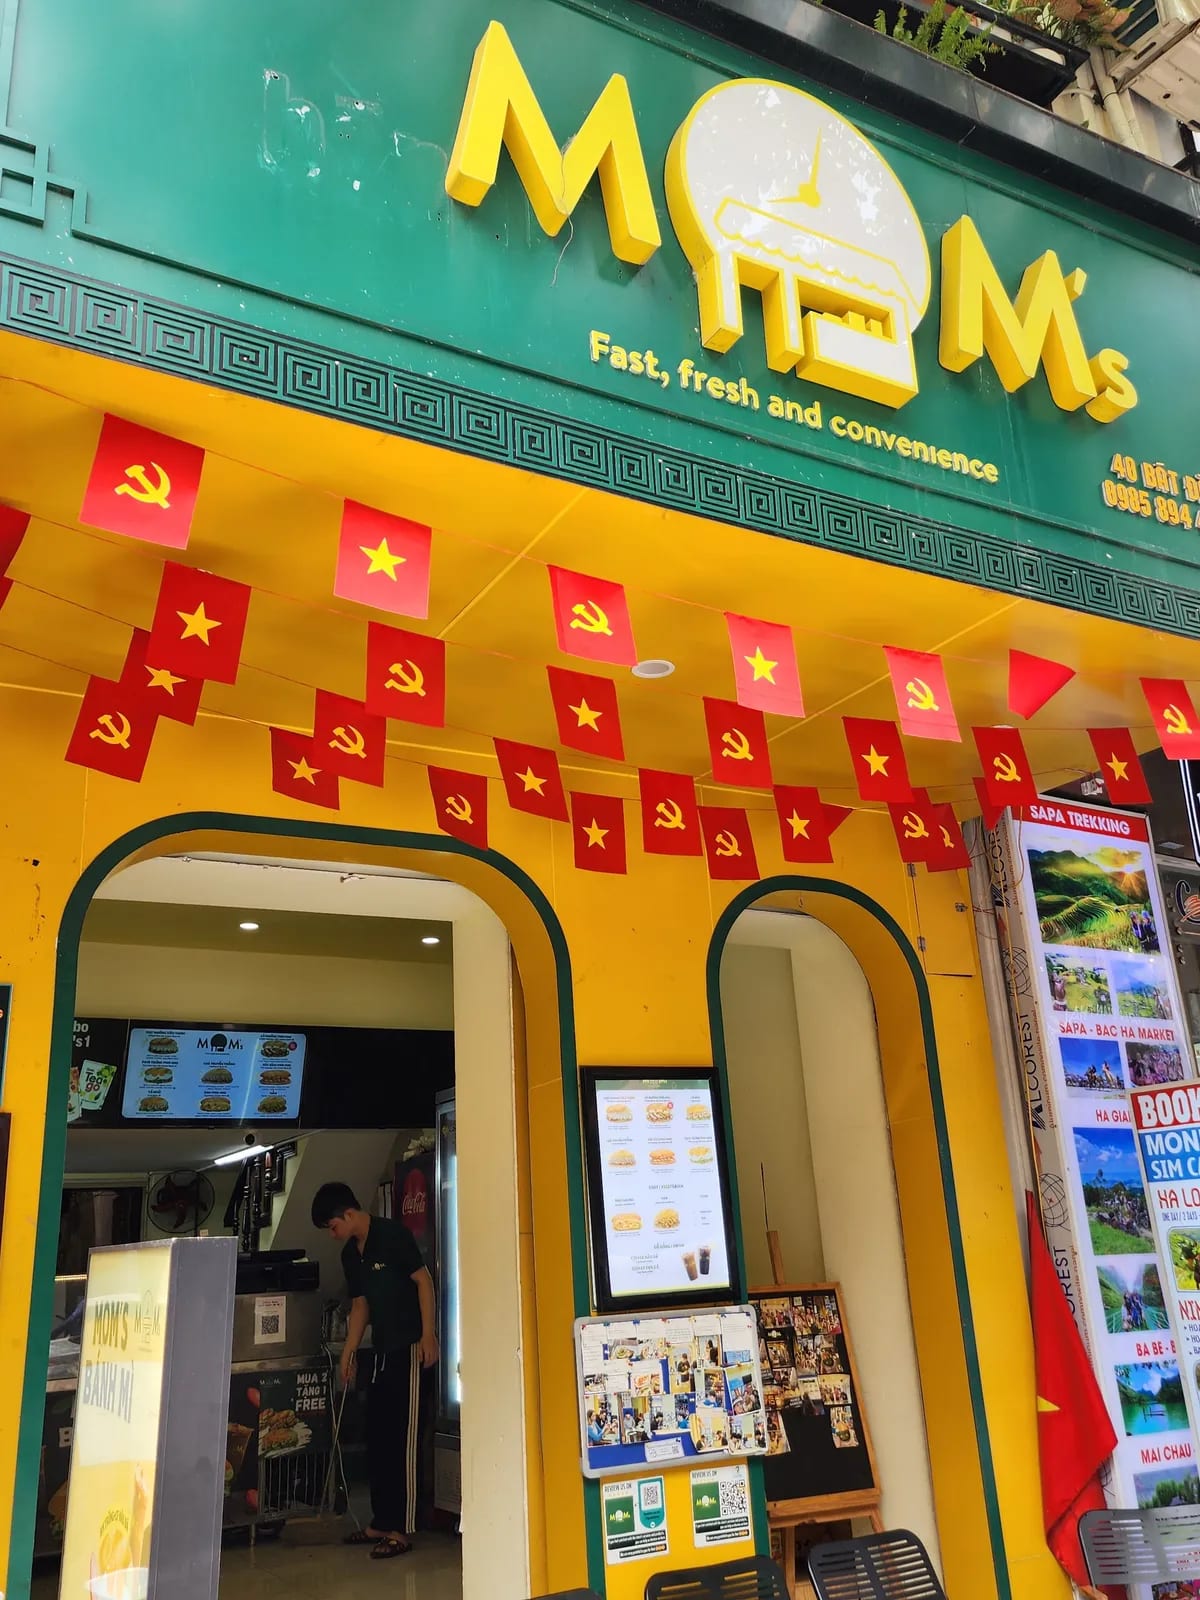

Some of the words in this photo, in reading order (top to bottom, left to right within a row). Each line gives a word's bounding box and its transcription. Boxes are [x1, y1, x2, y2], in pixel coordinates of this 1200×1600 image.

[589, 330, 670, 388] Fast,
[679, 357, 760, 411] fresh
[767, 393, 823, 431] and
[829, 415, 999, 485] convenience
[1110, 453, 1138, 483] 40
[1102, 479, 1152, 518] 0985
[1154, 496, 1193, 530] 894
[1030, 805, 1066, 824] SAPA
[1067, 810, 1131, 836] TREKKING
[1059, 1021, 1088, 1036] SAPA
[1095, 1023, 1118, 1037] BAC
[1120, 1026, 1136, 1039] HA
[1138, 1027, 1175, 1041] MARKET
[85, 1071, 103, 1085] Tea
[1095, 1109, 1109, 1123] HA
[1111, 1109, 1130, 1123] GIA
[1145, 1127, 1200, 1157] MON
[1150, 1158, 1183, 1180] SIM
[1187, 1157, 1200, 1177] C
[92, 1300, 130, 1352] MOM'S
[1136, 1342, 1150, 1357] BA
[1152, 1340, 1164, 1356] BE
[82, 1349, 118, 1416] BÁNH
[118, 1359, 135, 1424] MÌ
[297, 1373, 319, 1385] MUA
[321, 1372, 328, 1383] 2
[295, 1397, 327, 1413] FREE
[1140, 1448, 1162, 1465] MAI
[1164, 1442, 1192, 1462] CHAU
